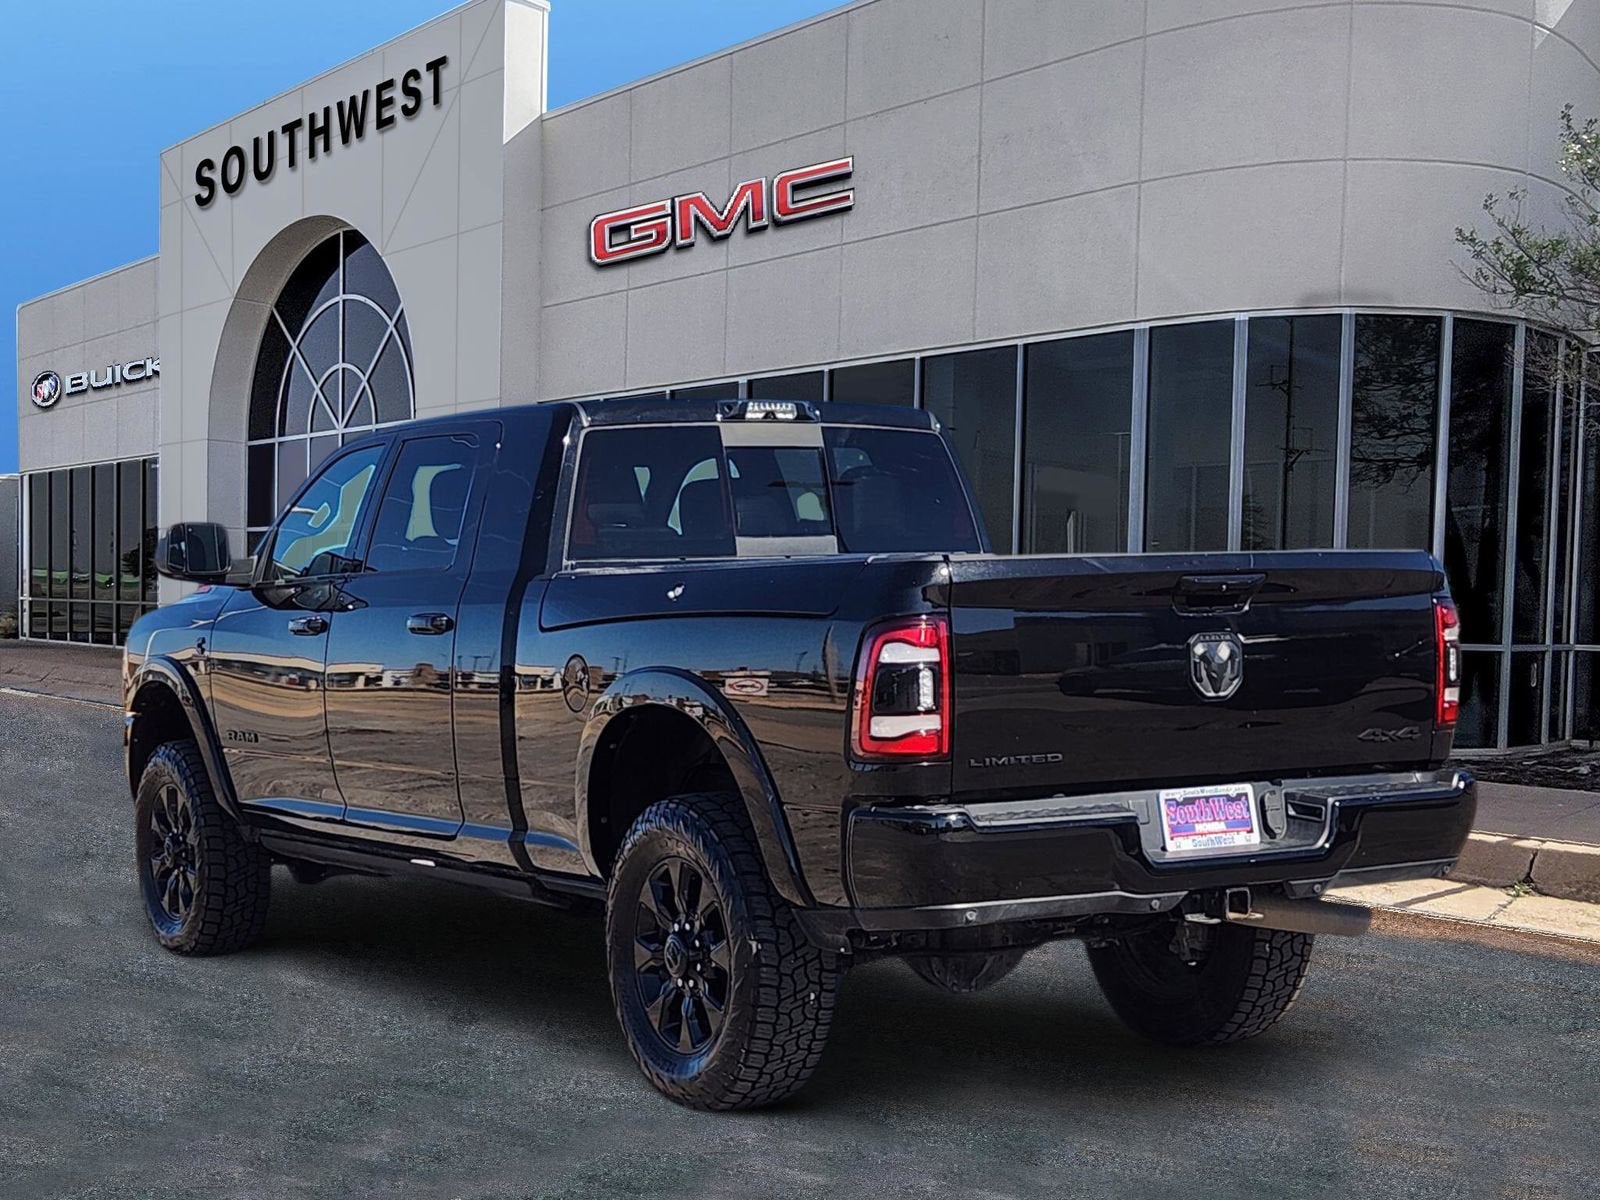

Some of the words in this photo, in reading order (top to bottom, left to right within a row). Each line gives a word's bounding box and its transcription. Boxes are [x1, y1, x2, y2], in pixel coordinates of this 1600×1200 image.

[194, 56, 449, 207] SOUTHWEST
[589, 156, 854, 269] GMC
[226, 730, 259, 743] RAM
[969, 753, 1063, 767] LIMITED
[1166, 796, 1249, 825] SouthWest
[1192, 835, 1235, 848] SouthWest
